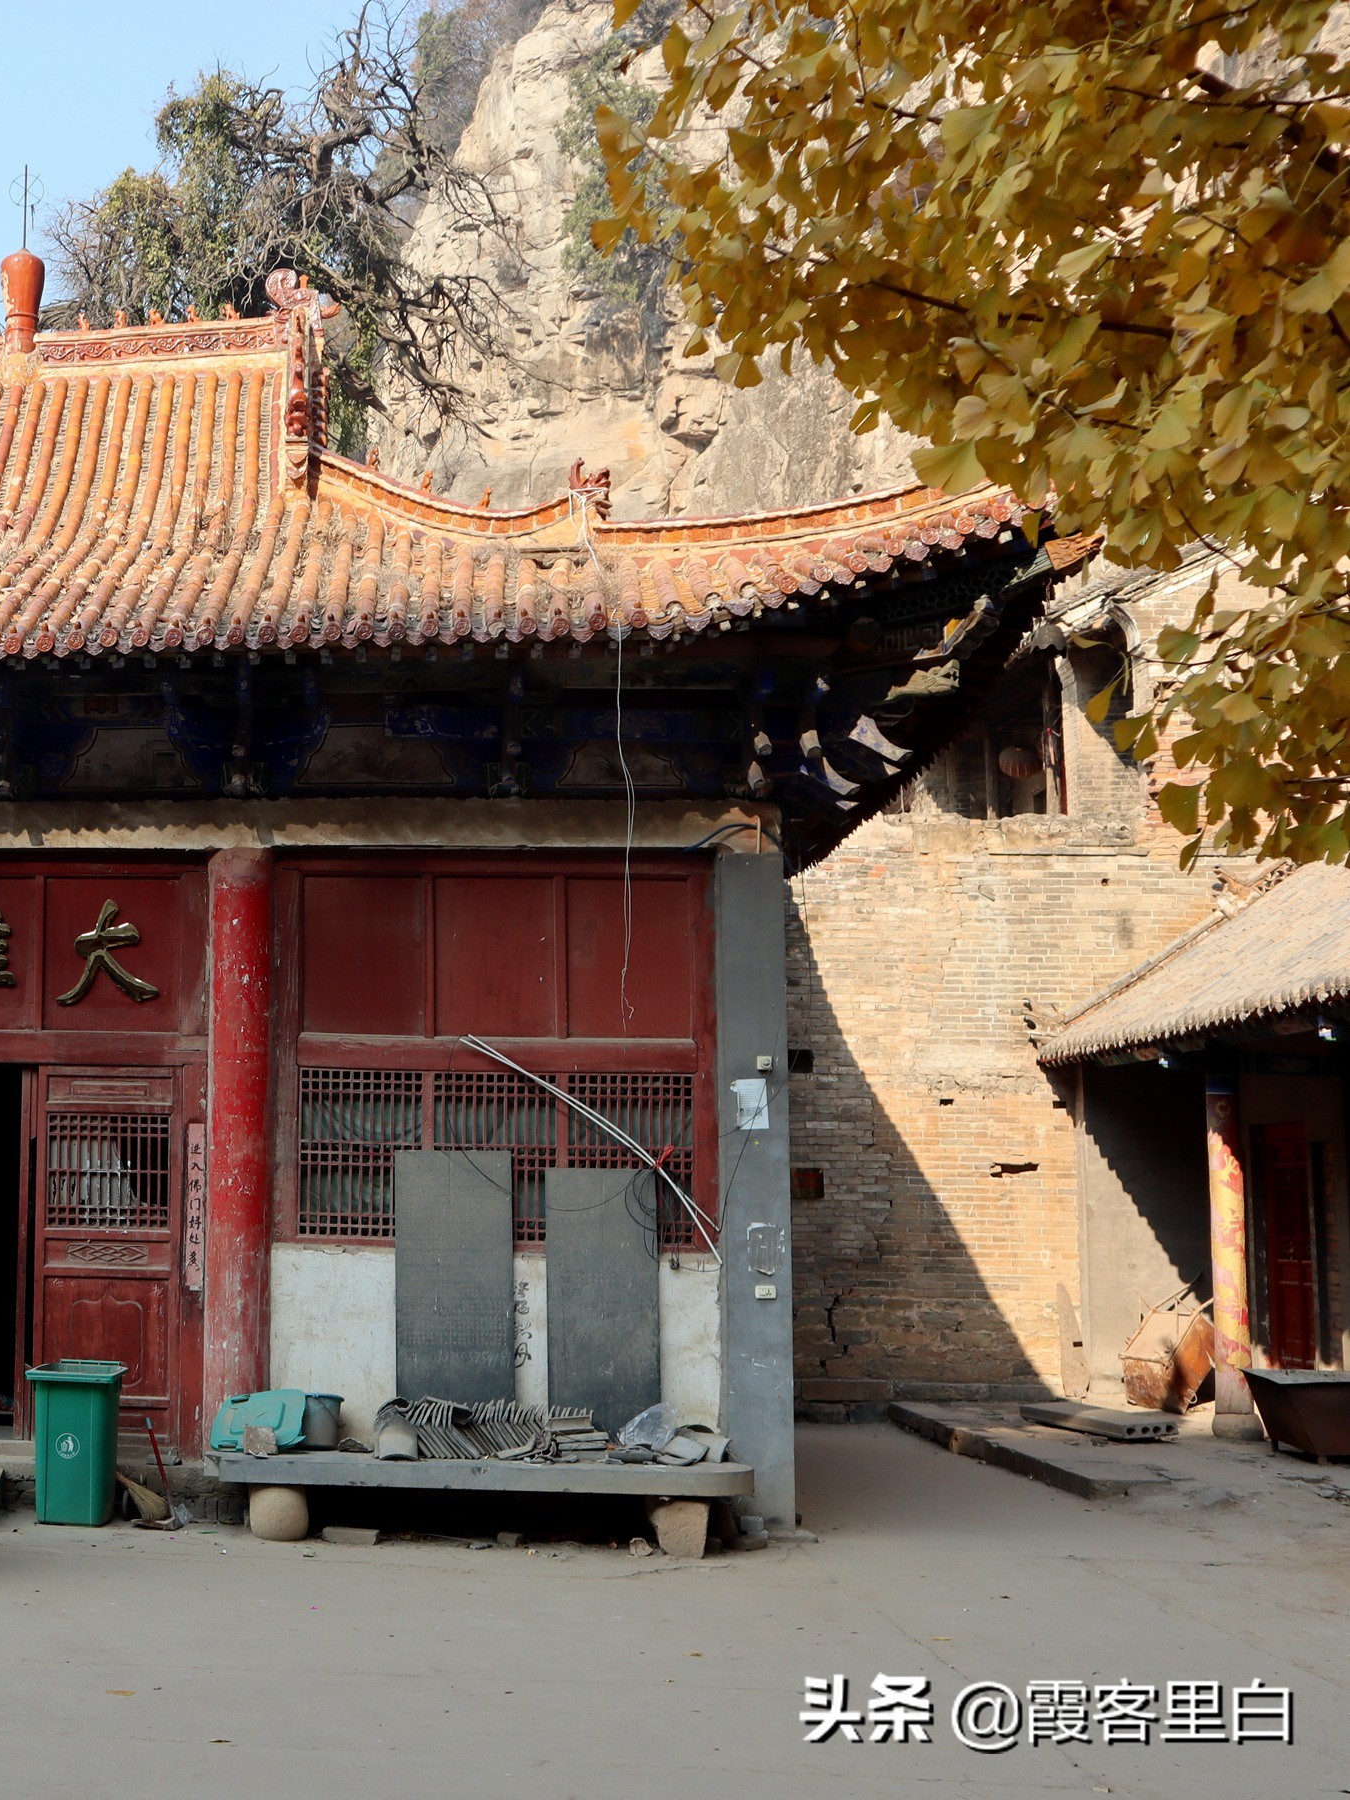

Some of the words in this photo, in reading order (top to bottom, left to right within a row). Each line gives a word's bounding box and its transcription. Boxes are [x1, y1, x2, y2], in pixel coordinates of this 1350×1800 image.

[187, 1143, 204, 1271] 进入佛门好处多
